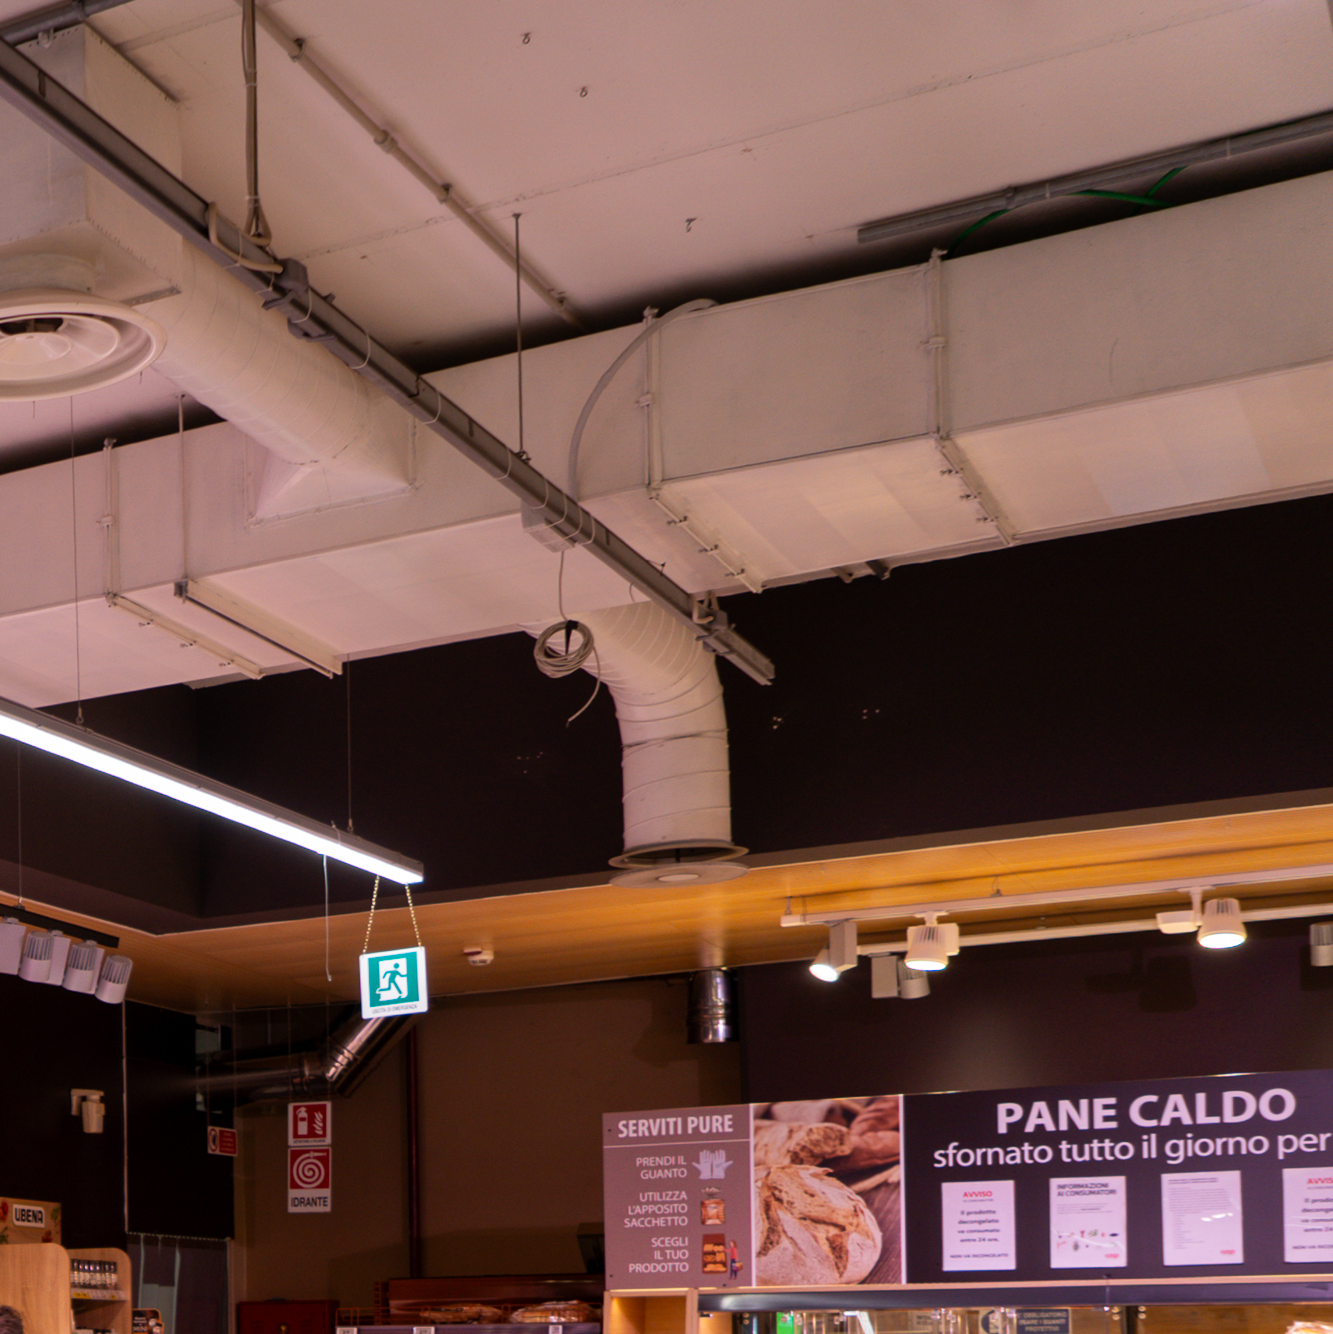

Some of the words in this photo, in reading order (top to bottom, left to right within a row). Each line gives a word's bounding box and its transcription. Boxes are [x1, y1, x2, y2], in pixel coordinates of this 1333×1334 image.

[997, 1097, 1119, 1134] PANE
[1129, 1088, 1296, 1127] CALDO
[618, 1117, 682, 1138] SERVITI
[687, 1115, 733, 1135] PURE
[933, 1142, 1053, 1168] sfornato
[1059, 1138, 1134, 1162] tutto
[1141, 1133, 1157, 1159] il
[1164, 1132, 1269, 1165] giorno
[1277, 1132, 1331, 1160] per
[636, 1157, 675, 1168] PRENDI
[677, 1156, 687, 1166] IL
[641, 1168, 687, 1180] GUANTO
[639, 1190, 687, 1202] UTILIZZA
[1065, 1189, 1116, 1197] CONSUMATORI
[291, 1196, 328, 1207] IDRANTE
[15, 1208, 44, 1224] UBENA
[624, 1217, 688, 1228] SACCHETTO
[651, 1237, 688, 1248] SCEGLI
[654, 1251, 663, 1260] IL
[665, 1250, 689, 1260] TUO
[628, 1262, 689, 1274] PRODOTTO
